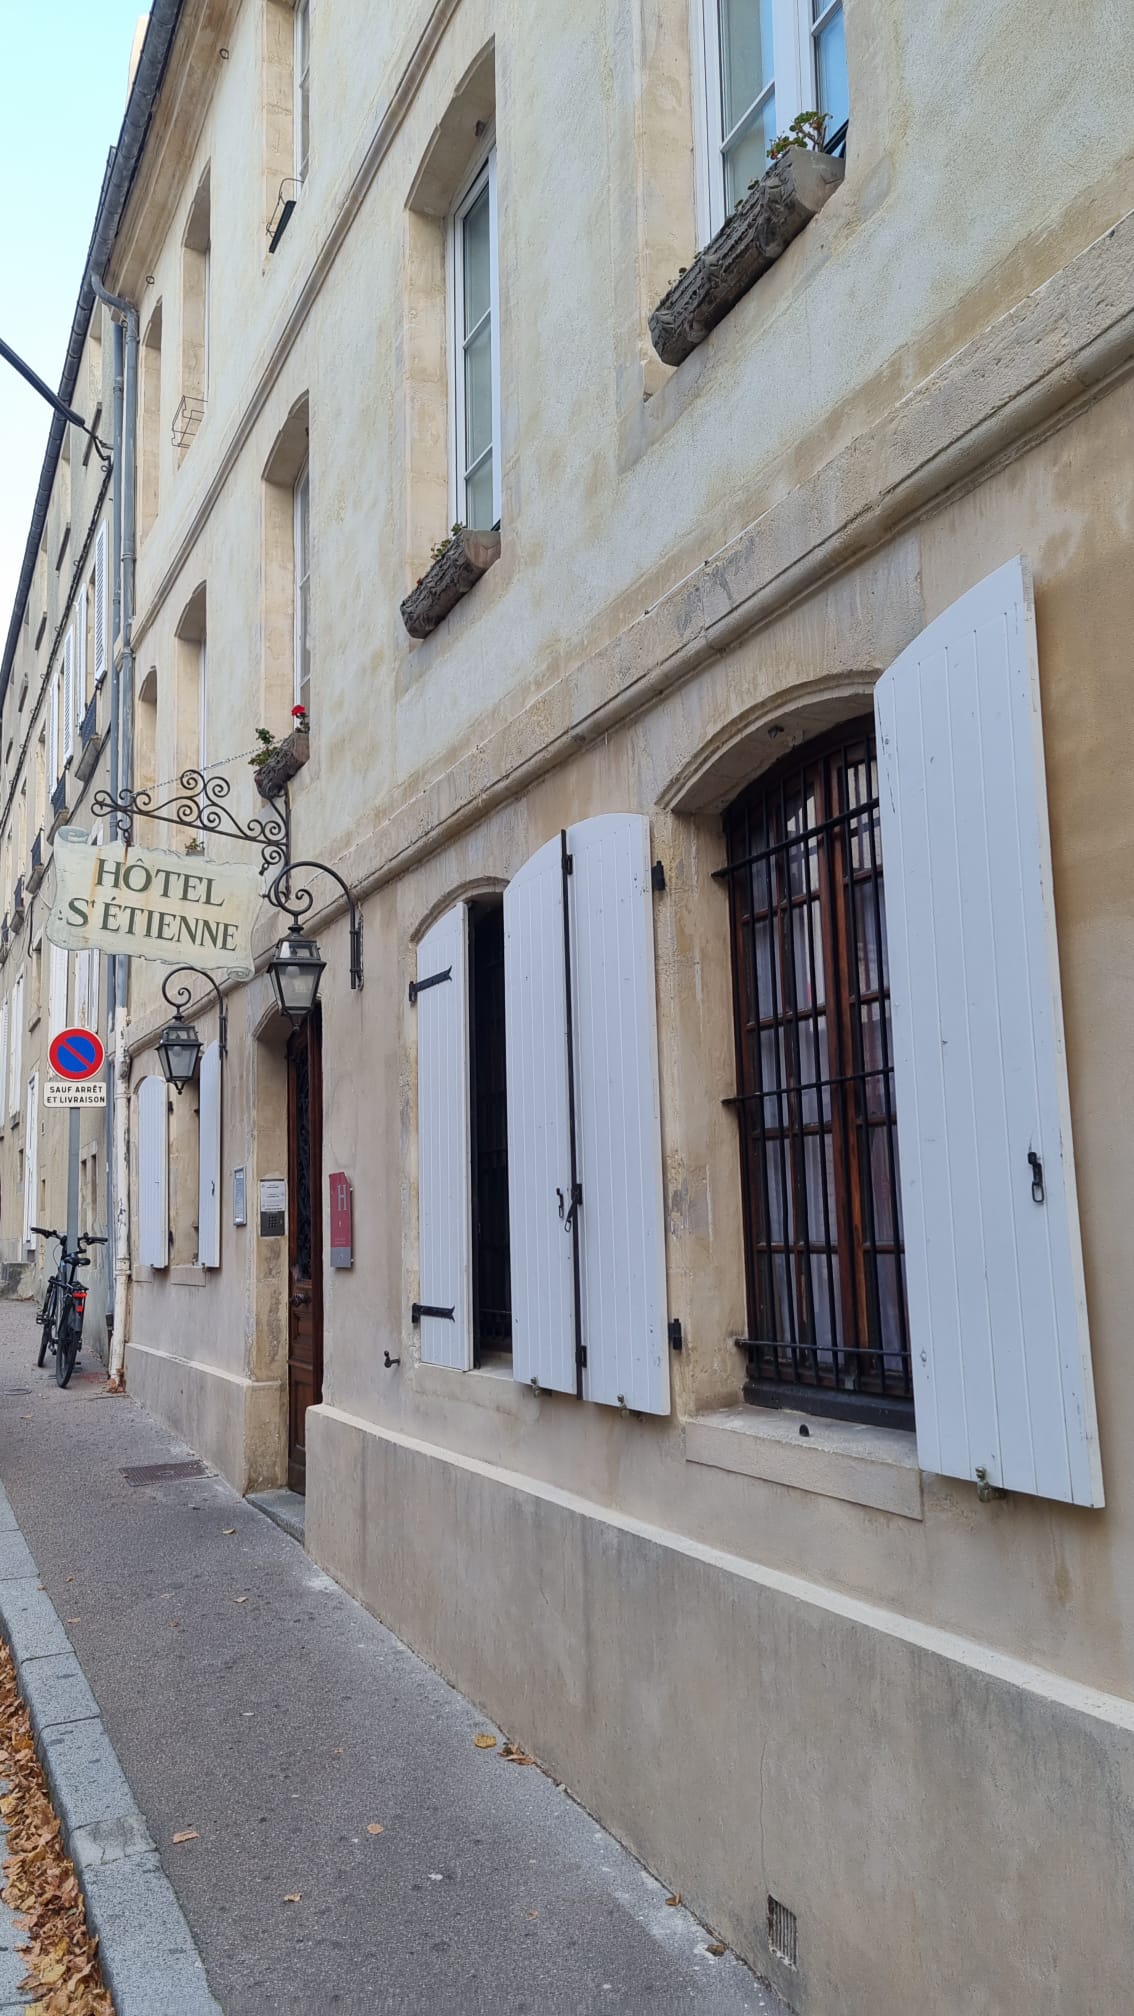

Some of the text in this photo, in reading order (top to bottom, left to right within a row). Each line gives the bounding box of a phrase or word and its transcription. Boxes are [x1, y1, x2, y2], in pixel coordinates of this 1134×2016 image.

[95, 858, 225, 907] HÔTEL
[100, 896, 239, 951] ÉTIENNE
[75, 1085, 102, 1093] ARRÊT
[337, 1184, 348, 1211] H
